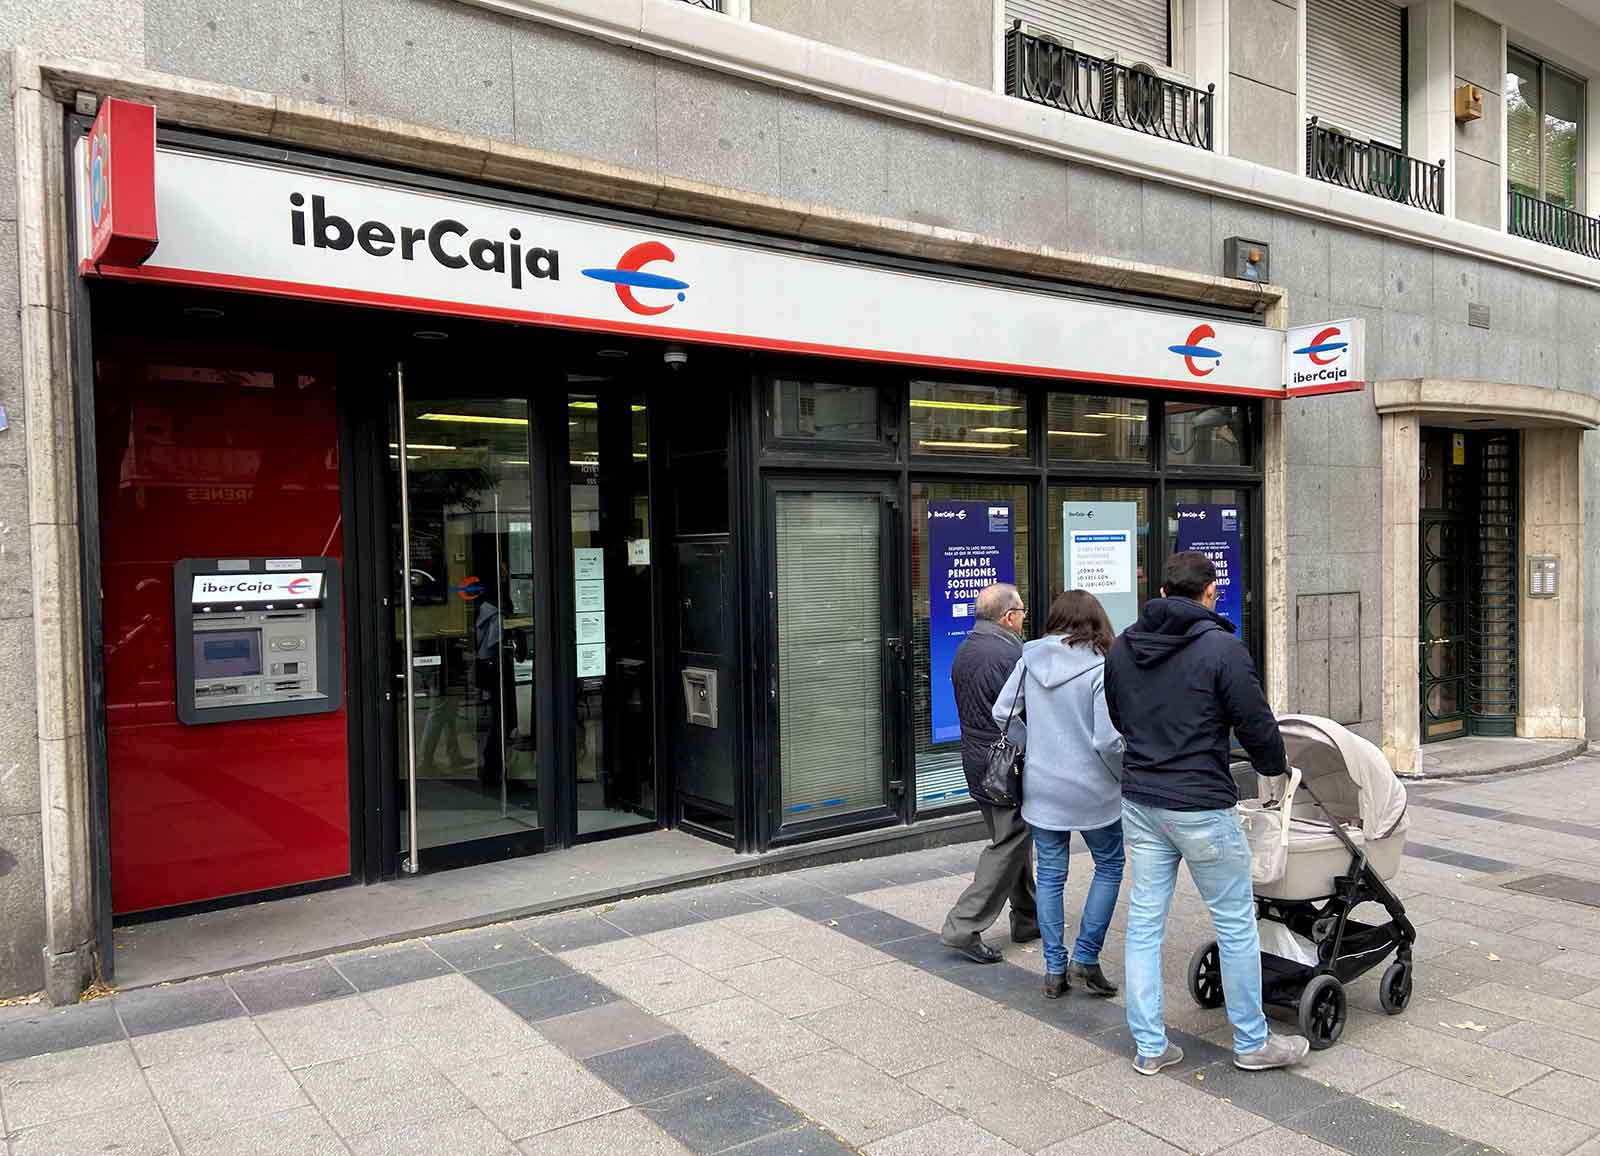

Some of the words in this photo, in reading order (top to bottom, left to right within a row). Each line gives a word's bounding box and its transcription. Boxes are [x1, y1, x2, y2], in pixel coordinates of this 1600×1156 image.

[289, 192, 561, 290] iberCaja
[1293, 367, 1348, 384] iberCaja
[1215, 551, 1223, 560] DE
[954, 557, 977, 567] PLAN
[980, 557, 990, 566] DE
[948, 567, 997, 578] PENSIONES
[202, 581, 273, 595] iberCaja
[944, 590, 951, 599] Y
